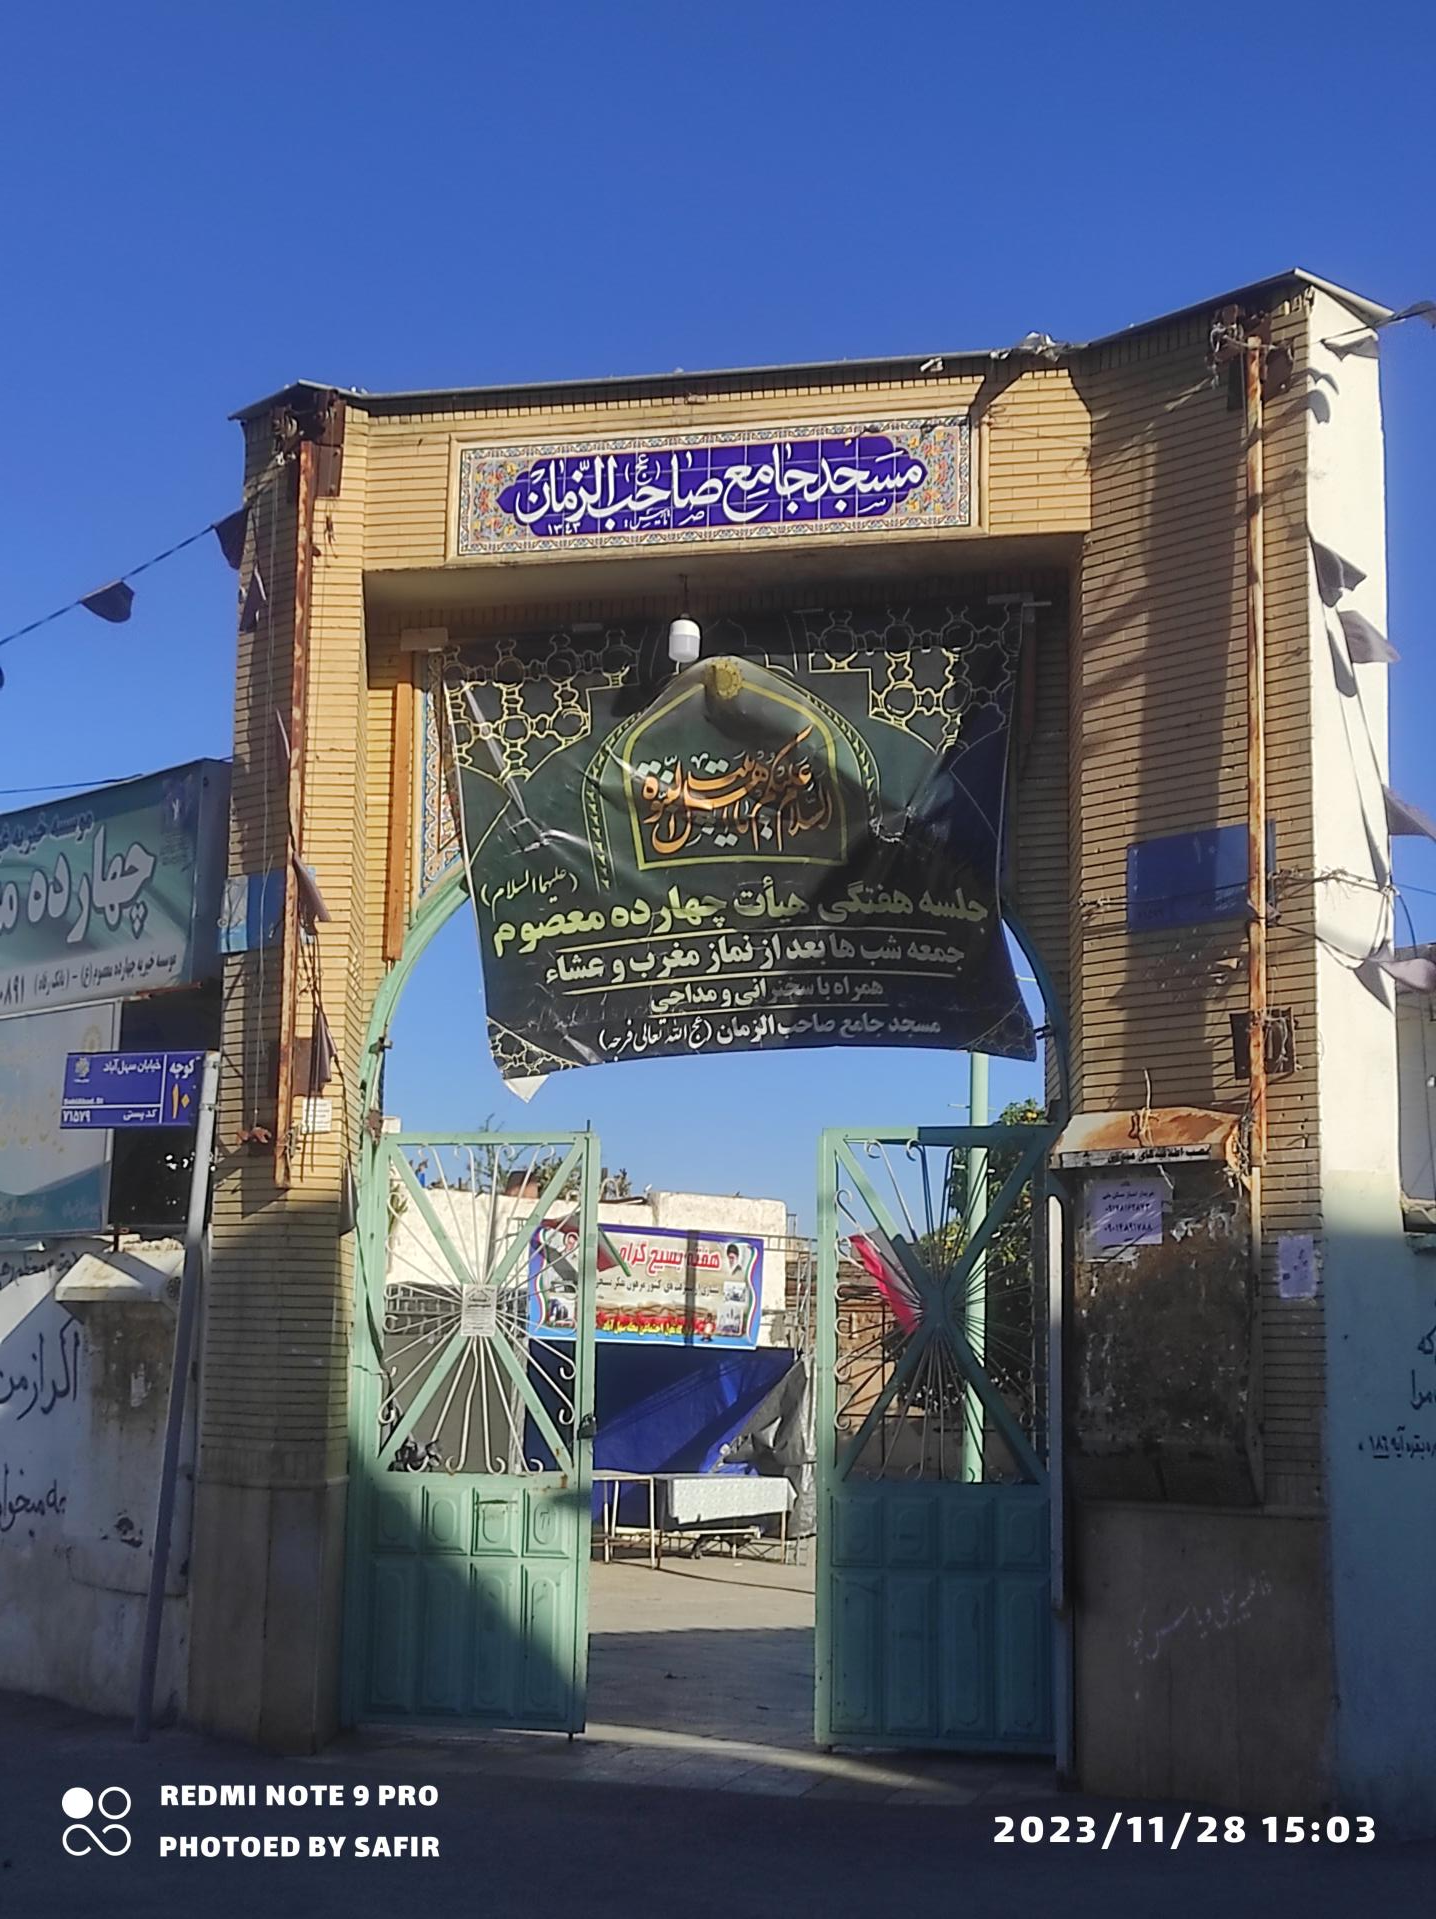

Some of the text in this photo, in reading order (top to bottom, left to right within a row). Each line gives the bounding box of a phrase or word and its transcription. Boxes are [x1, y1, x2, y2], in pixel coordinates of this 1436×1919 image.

[587, 451, 723, 530] صاحب
[723, 443, 818, 522] جامع
[803, 450, 923, 514] مسجد
[27, 824, 156, 944] چهارده
[610, 885, 728, 933] چهارده
[818, 880, 914, 922] هفتگی
[918, 887, 989, 934] جلسه
[493, 909, 606, 957] معصوم
[546, 932, 965, 984] جمعه شب ها بعد از نماز مغرب و عشاء
[650, 983, 718, 1012] مداحی
[720, 988, 733, 1008] و
[816, 976, 830, 994] با
[833, 976, 884, 1001] همراه
[716, 1014, 775, 1044] الزمان
[777, 1012, 836, 1039] صاحب
[839, 1012, 885, 1038] جامع
[888, 1015, 941, 1038] مسجد
[137, 1058, 162, 1073] خیابان
[169, 1058, 196, 1079] کوچه
[122, 1109, 158, 1121] کد پستی
[171, 1083, 191, 1120] ۱۰
[648, 1247, 686, 1274] بسیج
